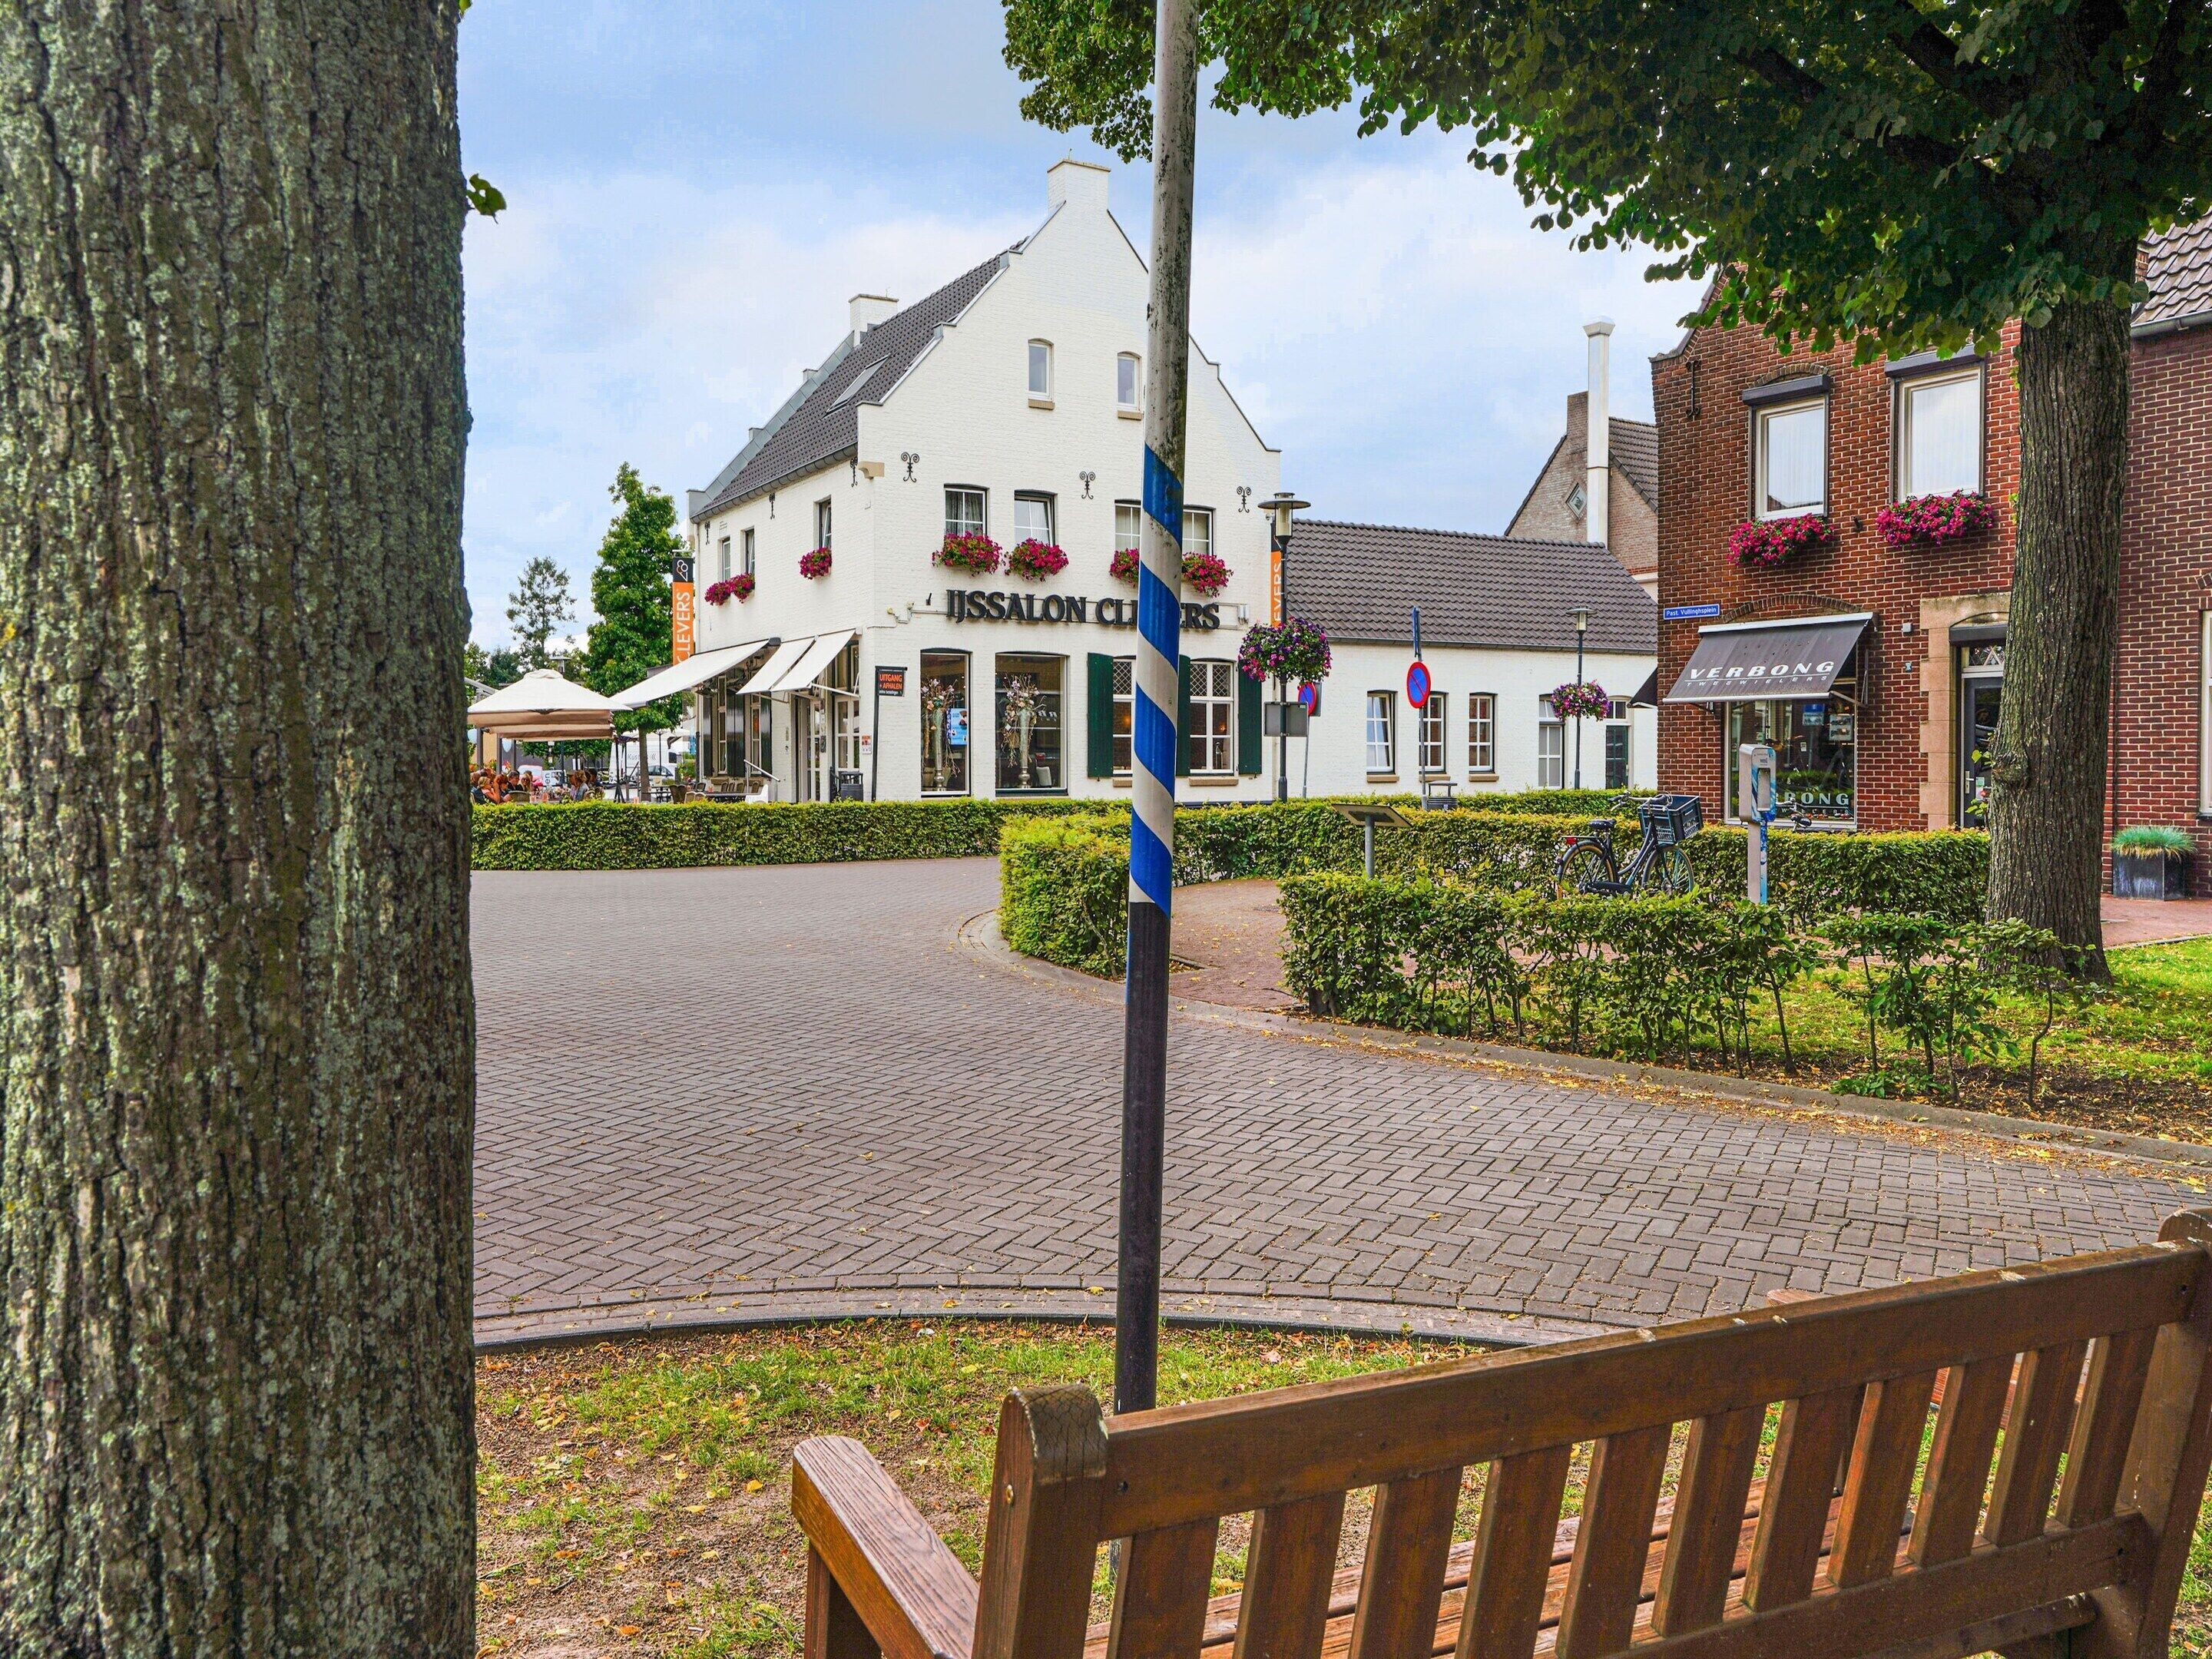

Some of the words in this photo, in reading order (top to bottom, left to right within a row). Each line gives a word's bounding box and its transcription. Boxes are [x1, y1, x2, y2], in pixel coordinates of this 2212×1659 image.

[946, 589, 1088, 624] IJSSALON
[1095, 598, 1220, 630] CLRS
[879, 673, 902, 682] UITGANG
[1690, 661, 1835, 680] VERBONG
[1687, 675, 1827, 687] TWESWIELERS
